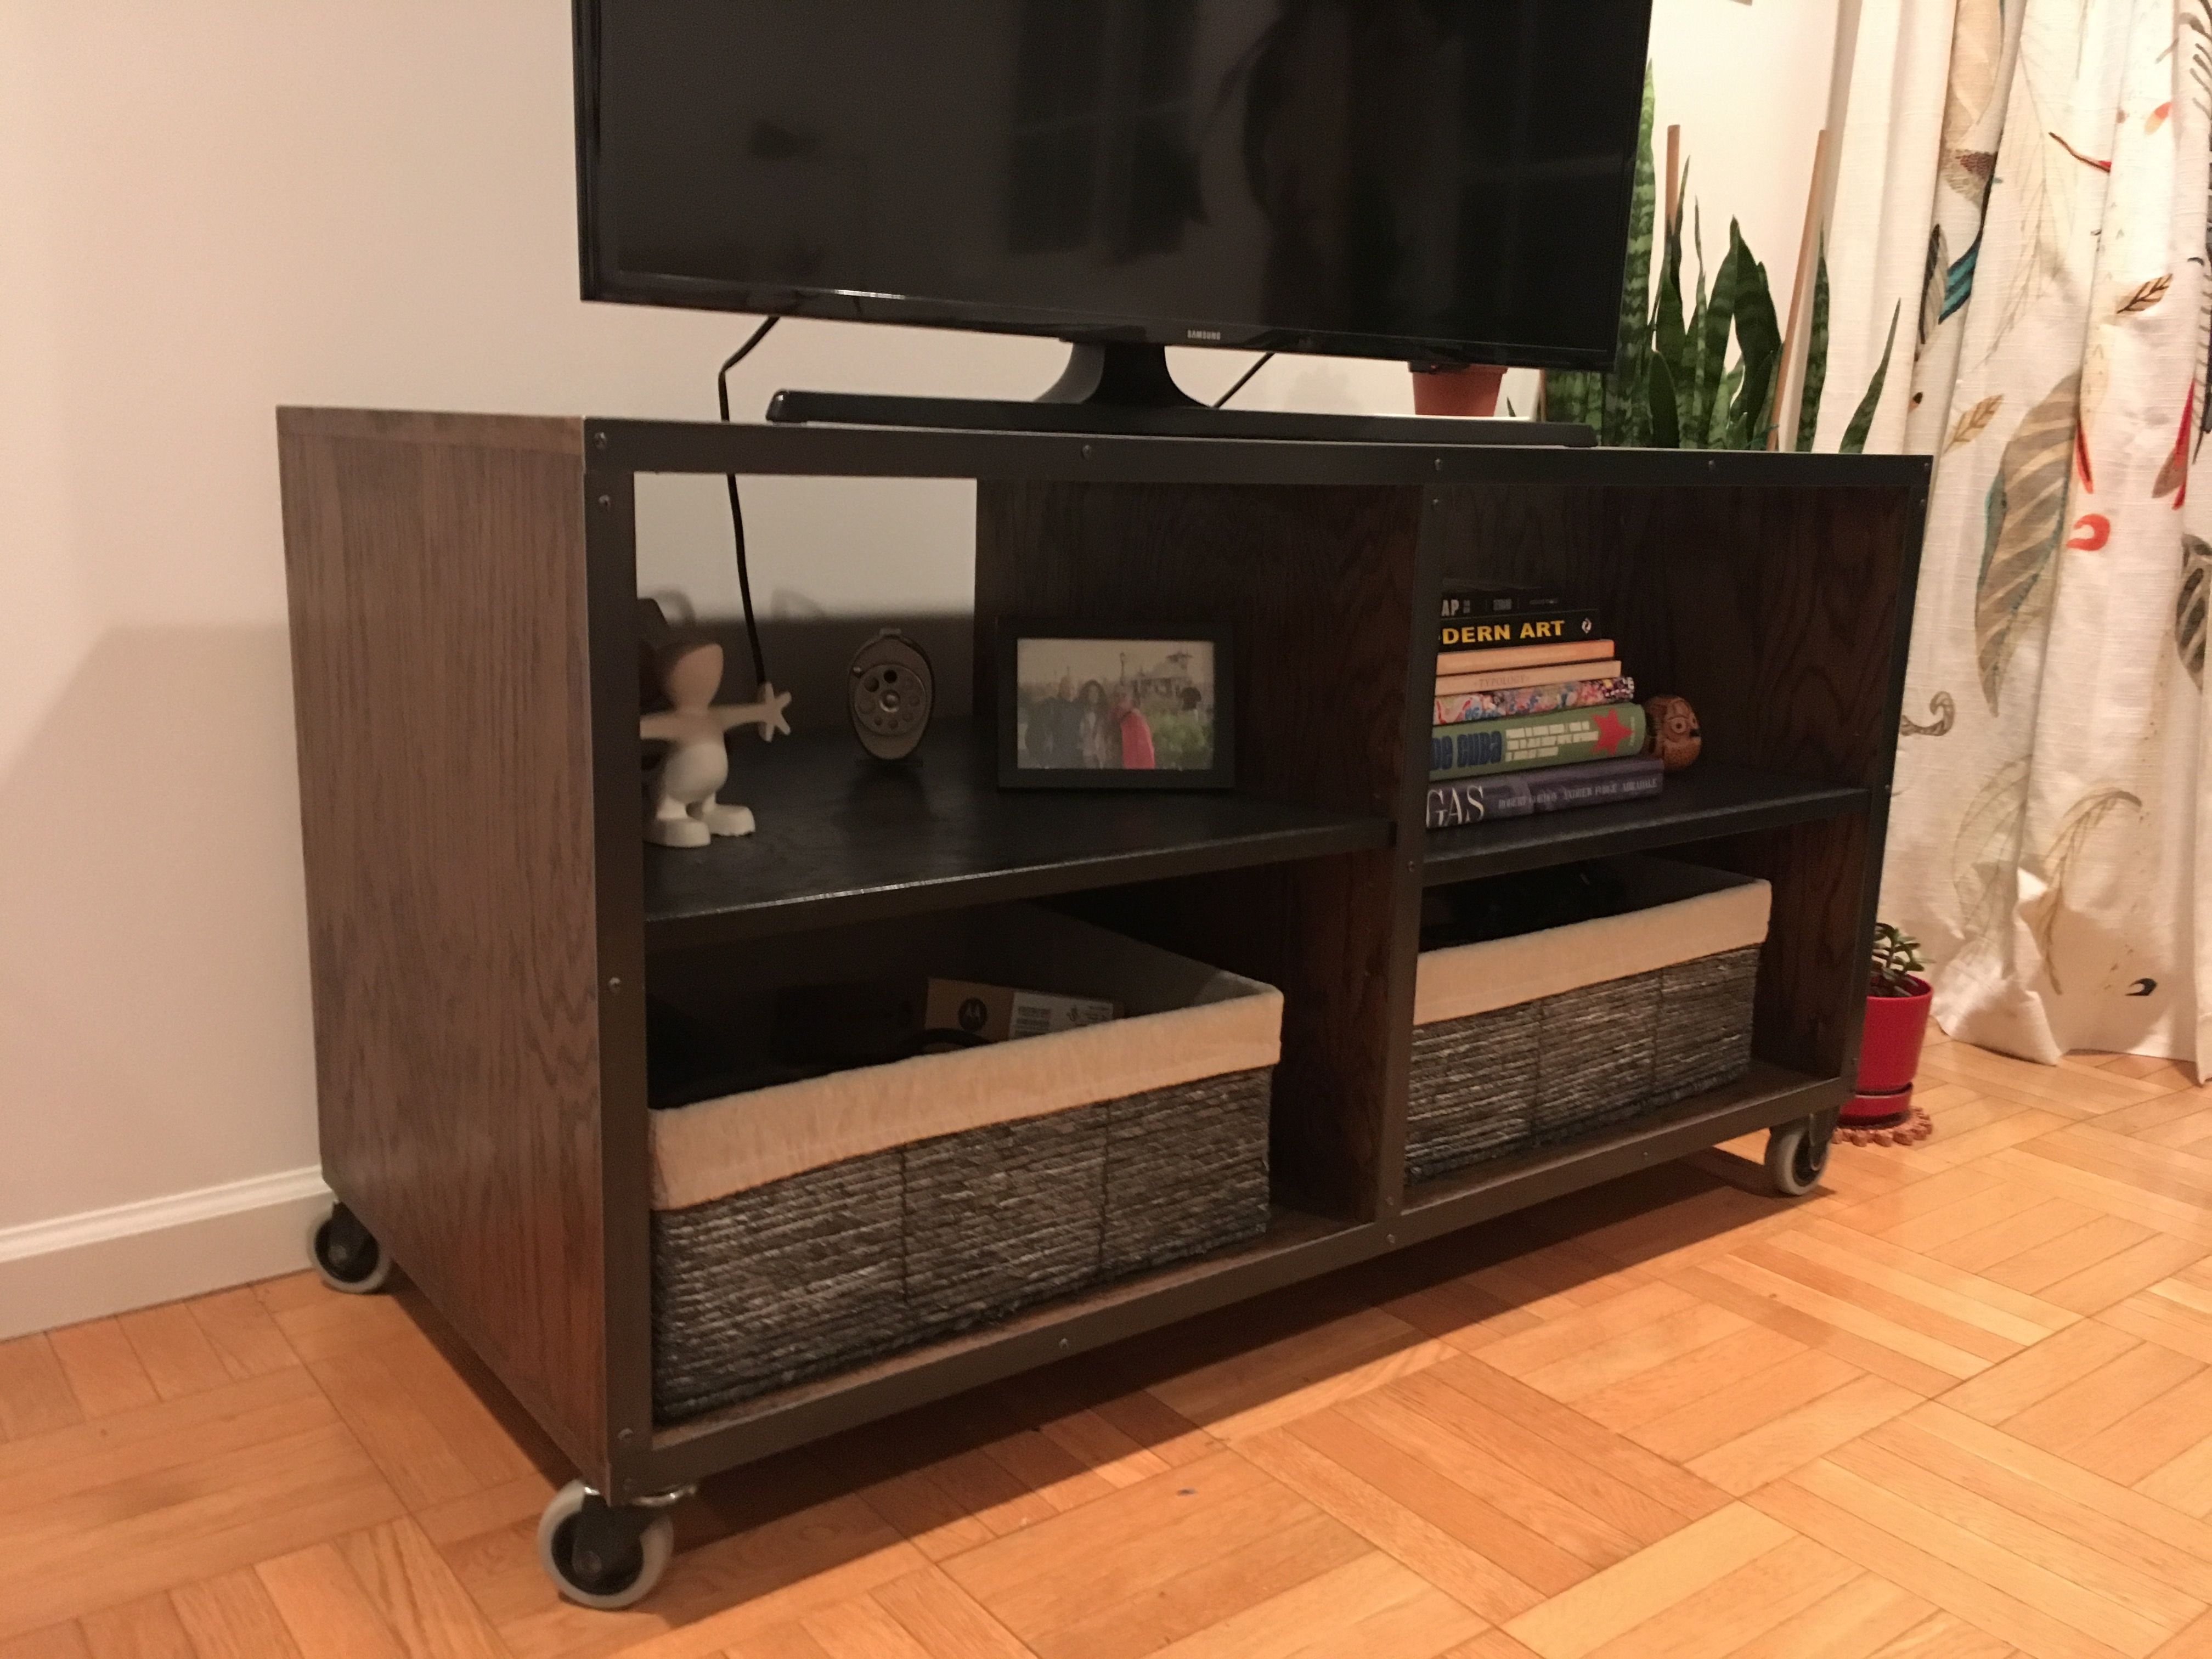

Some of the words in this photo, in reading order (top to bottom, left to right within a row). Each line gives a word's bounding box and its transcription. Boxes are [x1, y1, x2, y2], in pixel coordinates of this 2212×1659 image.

[1187, 329, 1221, 340] SAMSUNG
[1442, 624, 1510, 645] DERN
[1520, 620, 1565, 639] ART
[1426, 785, 1484, 827] GAS
